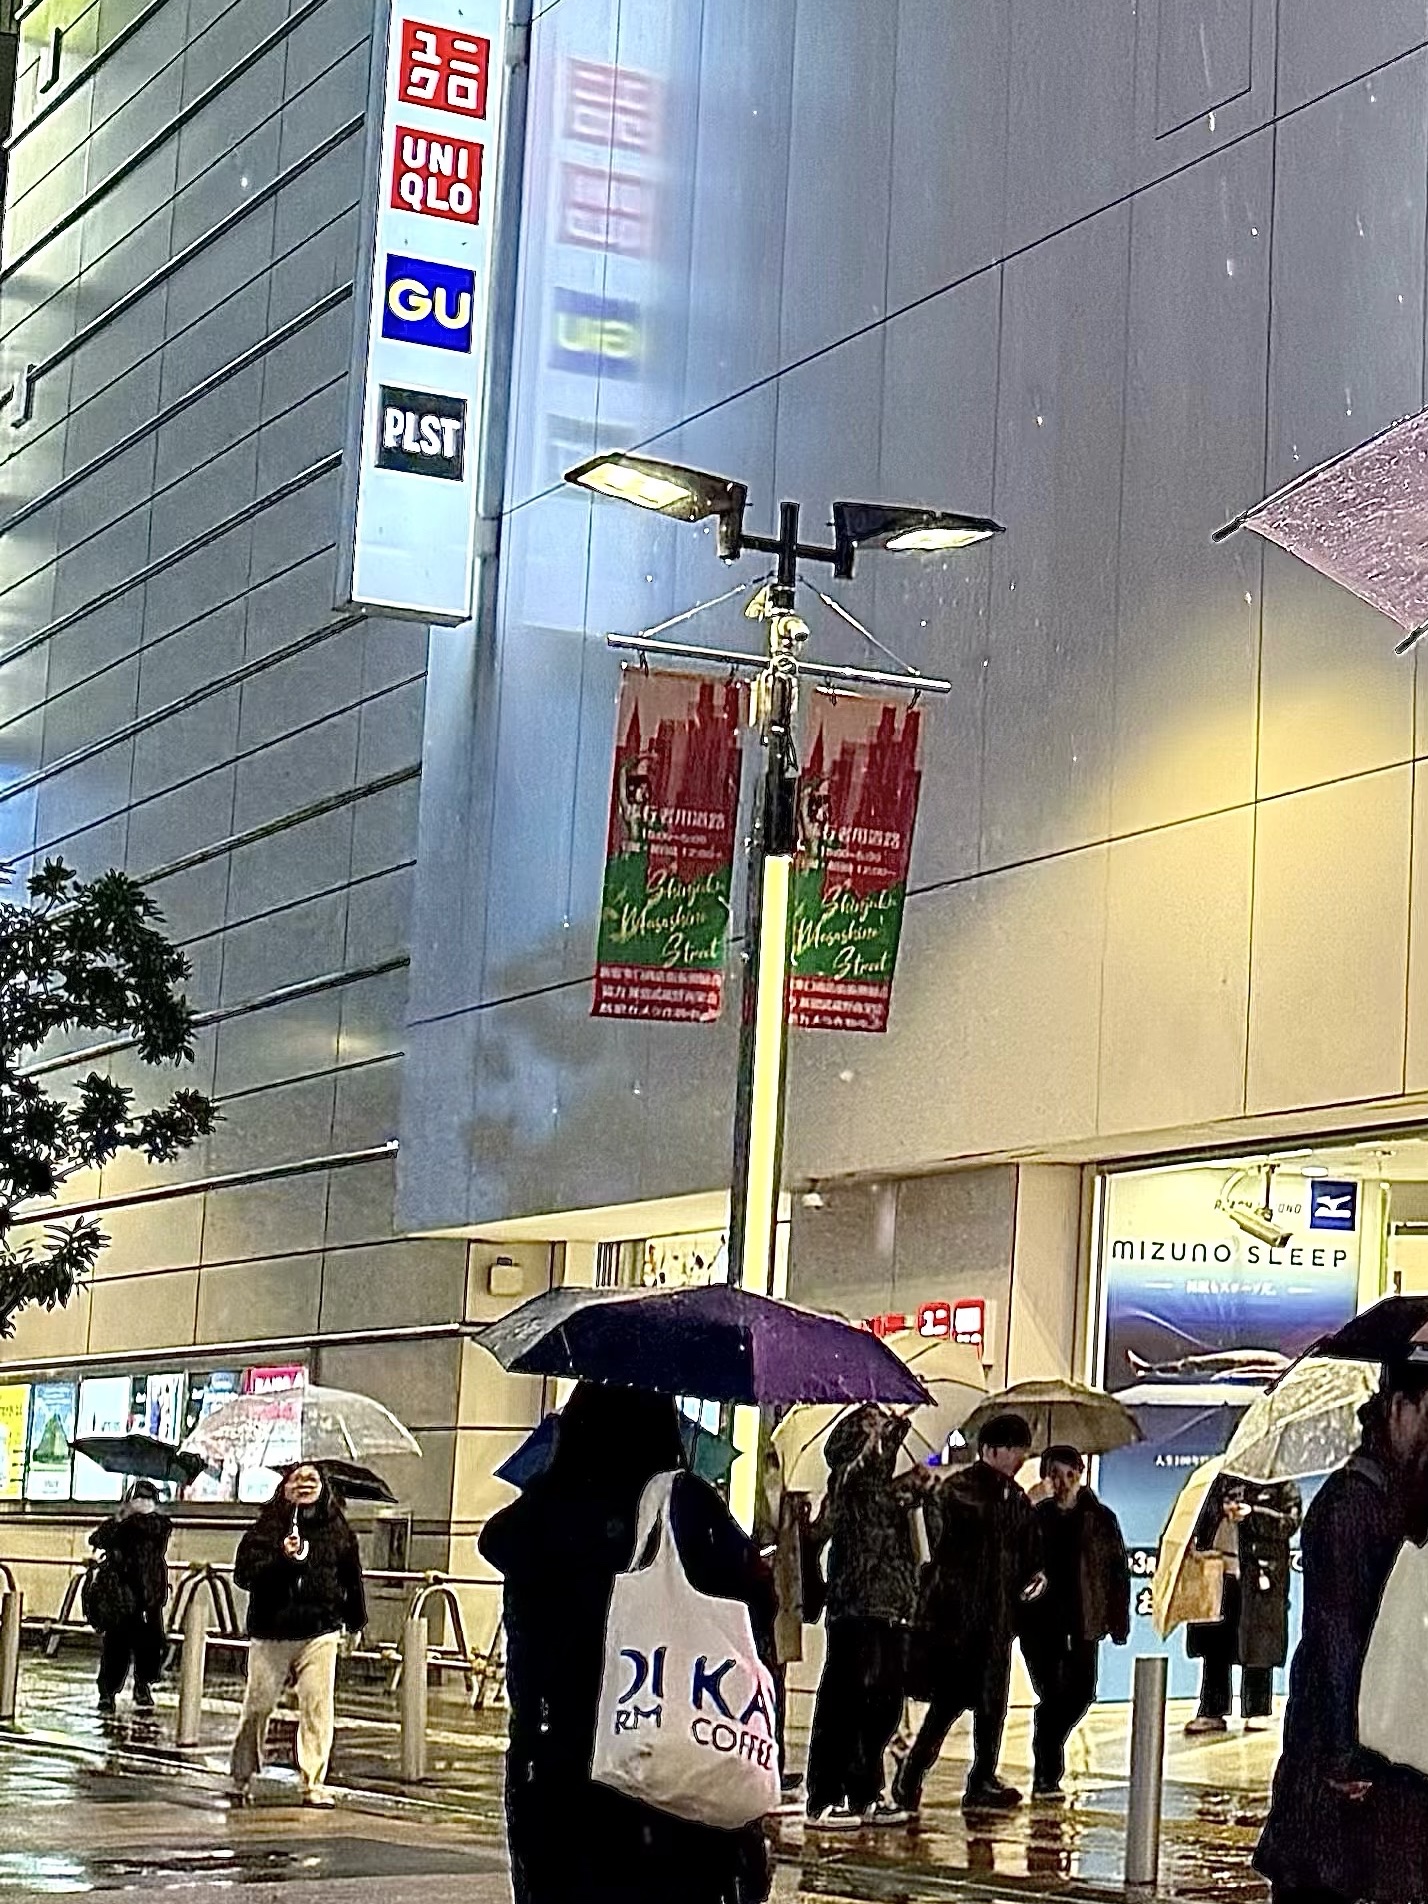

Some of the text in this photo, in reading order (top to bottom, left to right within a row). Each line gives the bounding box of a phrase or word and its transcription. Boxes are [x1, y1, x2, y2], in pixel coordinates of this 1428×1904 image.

[411, 29, 481, 75] ユニ
[406, 66, 479, 110] クロ
[402, 135, 469, 180] UNI
[400, 172, 473, 215] QLO
[387, 277, 472, 330] GU
[383, 407, 461, 458] PLST
[661, 932, 718, 968] Street
[834, 945, 887, 980] Street
[1246, 1245, 1348, 1268] SLEEP
[692, 1654, 775, 1739] KA
